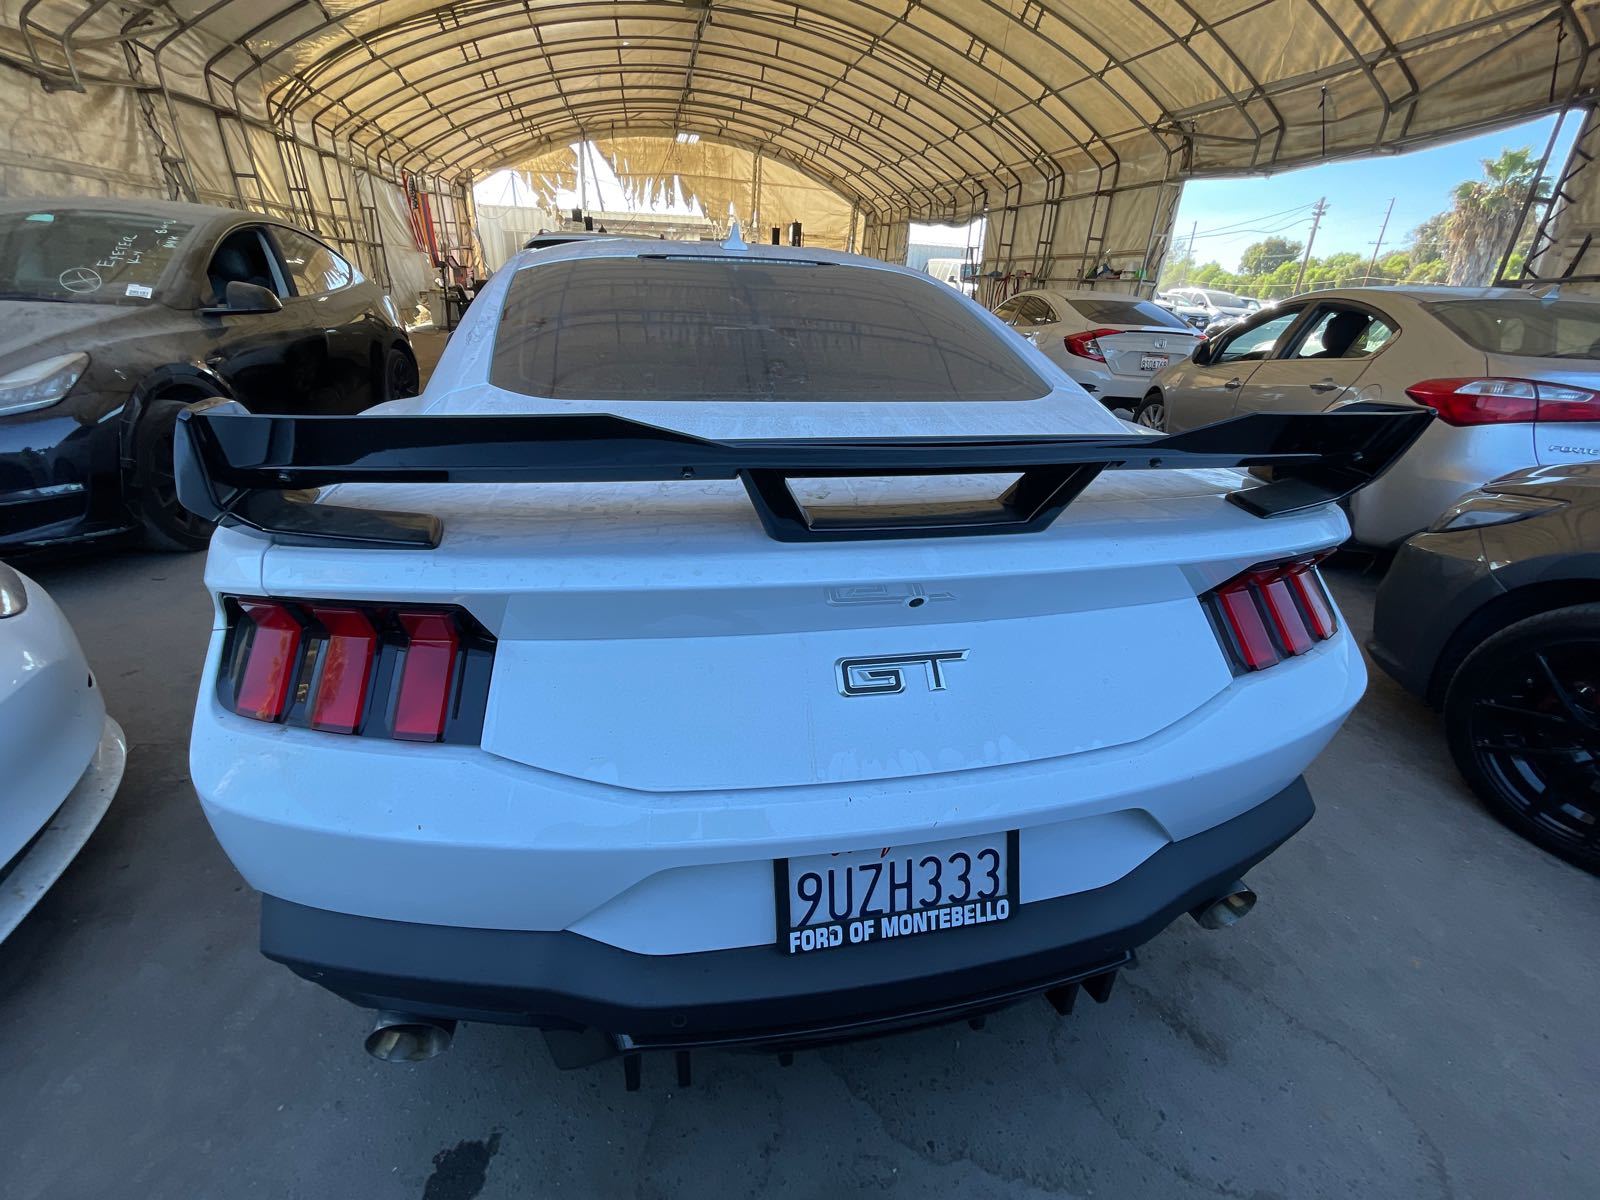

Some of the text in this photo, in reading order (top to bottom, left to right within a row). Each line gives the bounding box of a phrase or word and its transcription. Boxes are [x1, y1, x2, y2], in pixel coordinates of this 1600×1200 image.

[1549, 445, 1599, 456] FORTE
[834, 649, 972, 697] GT
[797, 848, 1000, 927] 9UZH333
[789, 899, 1009, 954] FORD OF MONTEBELLO
